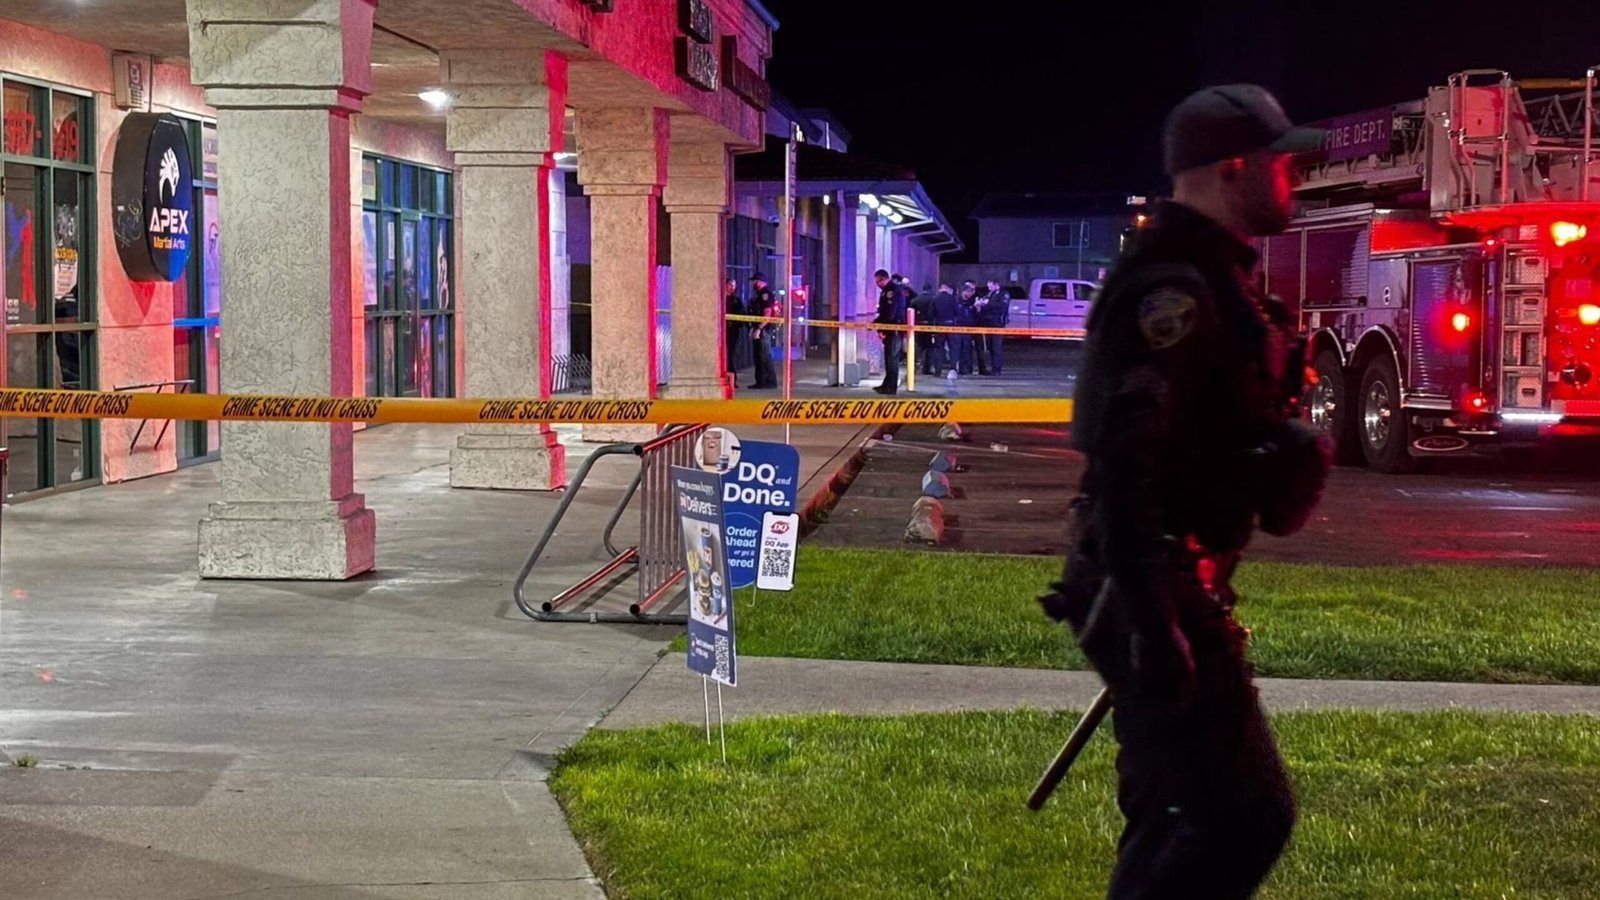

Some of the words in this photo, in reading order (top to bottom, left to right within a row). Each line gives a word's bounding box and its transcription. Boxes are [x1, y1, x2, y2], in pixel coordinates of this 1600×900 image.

[1325, 126, 1350, 150] FIRE
[1353, 119, 1385, 145] DEPT.
[149, 207, 189, 235] APEX
[153, 236, 172, 249] Martial
[173, 238, 185, 250] Arts
[19, 391, 57, 413] SCENE
[53, 393, 73, 414] DO
[70, 393, 98, 414] NOT
[94, 394, 133, 415] CROSS
[222, 397, 264, 417] CRIME
[258, 398, 300, 418] SCENE
[295, 398, 317, 418] DO
[313, 398, 340, 418] NOT
[339, 399, 382, 419] CROSS
[479, 400, 523, 420] CRIME
[519, 400, 563, 420] SCENE
[559, 400, 582, 420] DO
[578, 400, 611, 420] NOT
[606, 401, 653, 420] CROSS
[761, 400, 809, 419] CRIME
[805, 400, 854, 419] SCENE
[850, 401, 875, 419] DO
[872, 401, 907, 419] NOT
[903, 400, 953, 419] CROSS
[738, 462, 776, 486] DQ
[775, 476, 792, 486] and
[723, 482, 790, 507] Done.
[726, 526, 758, 537] Order
